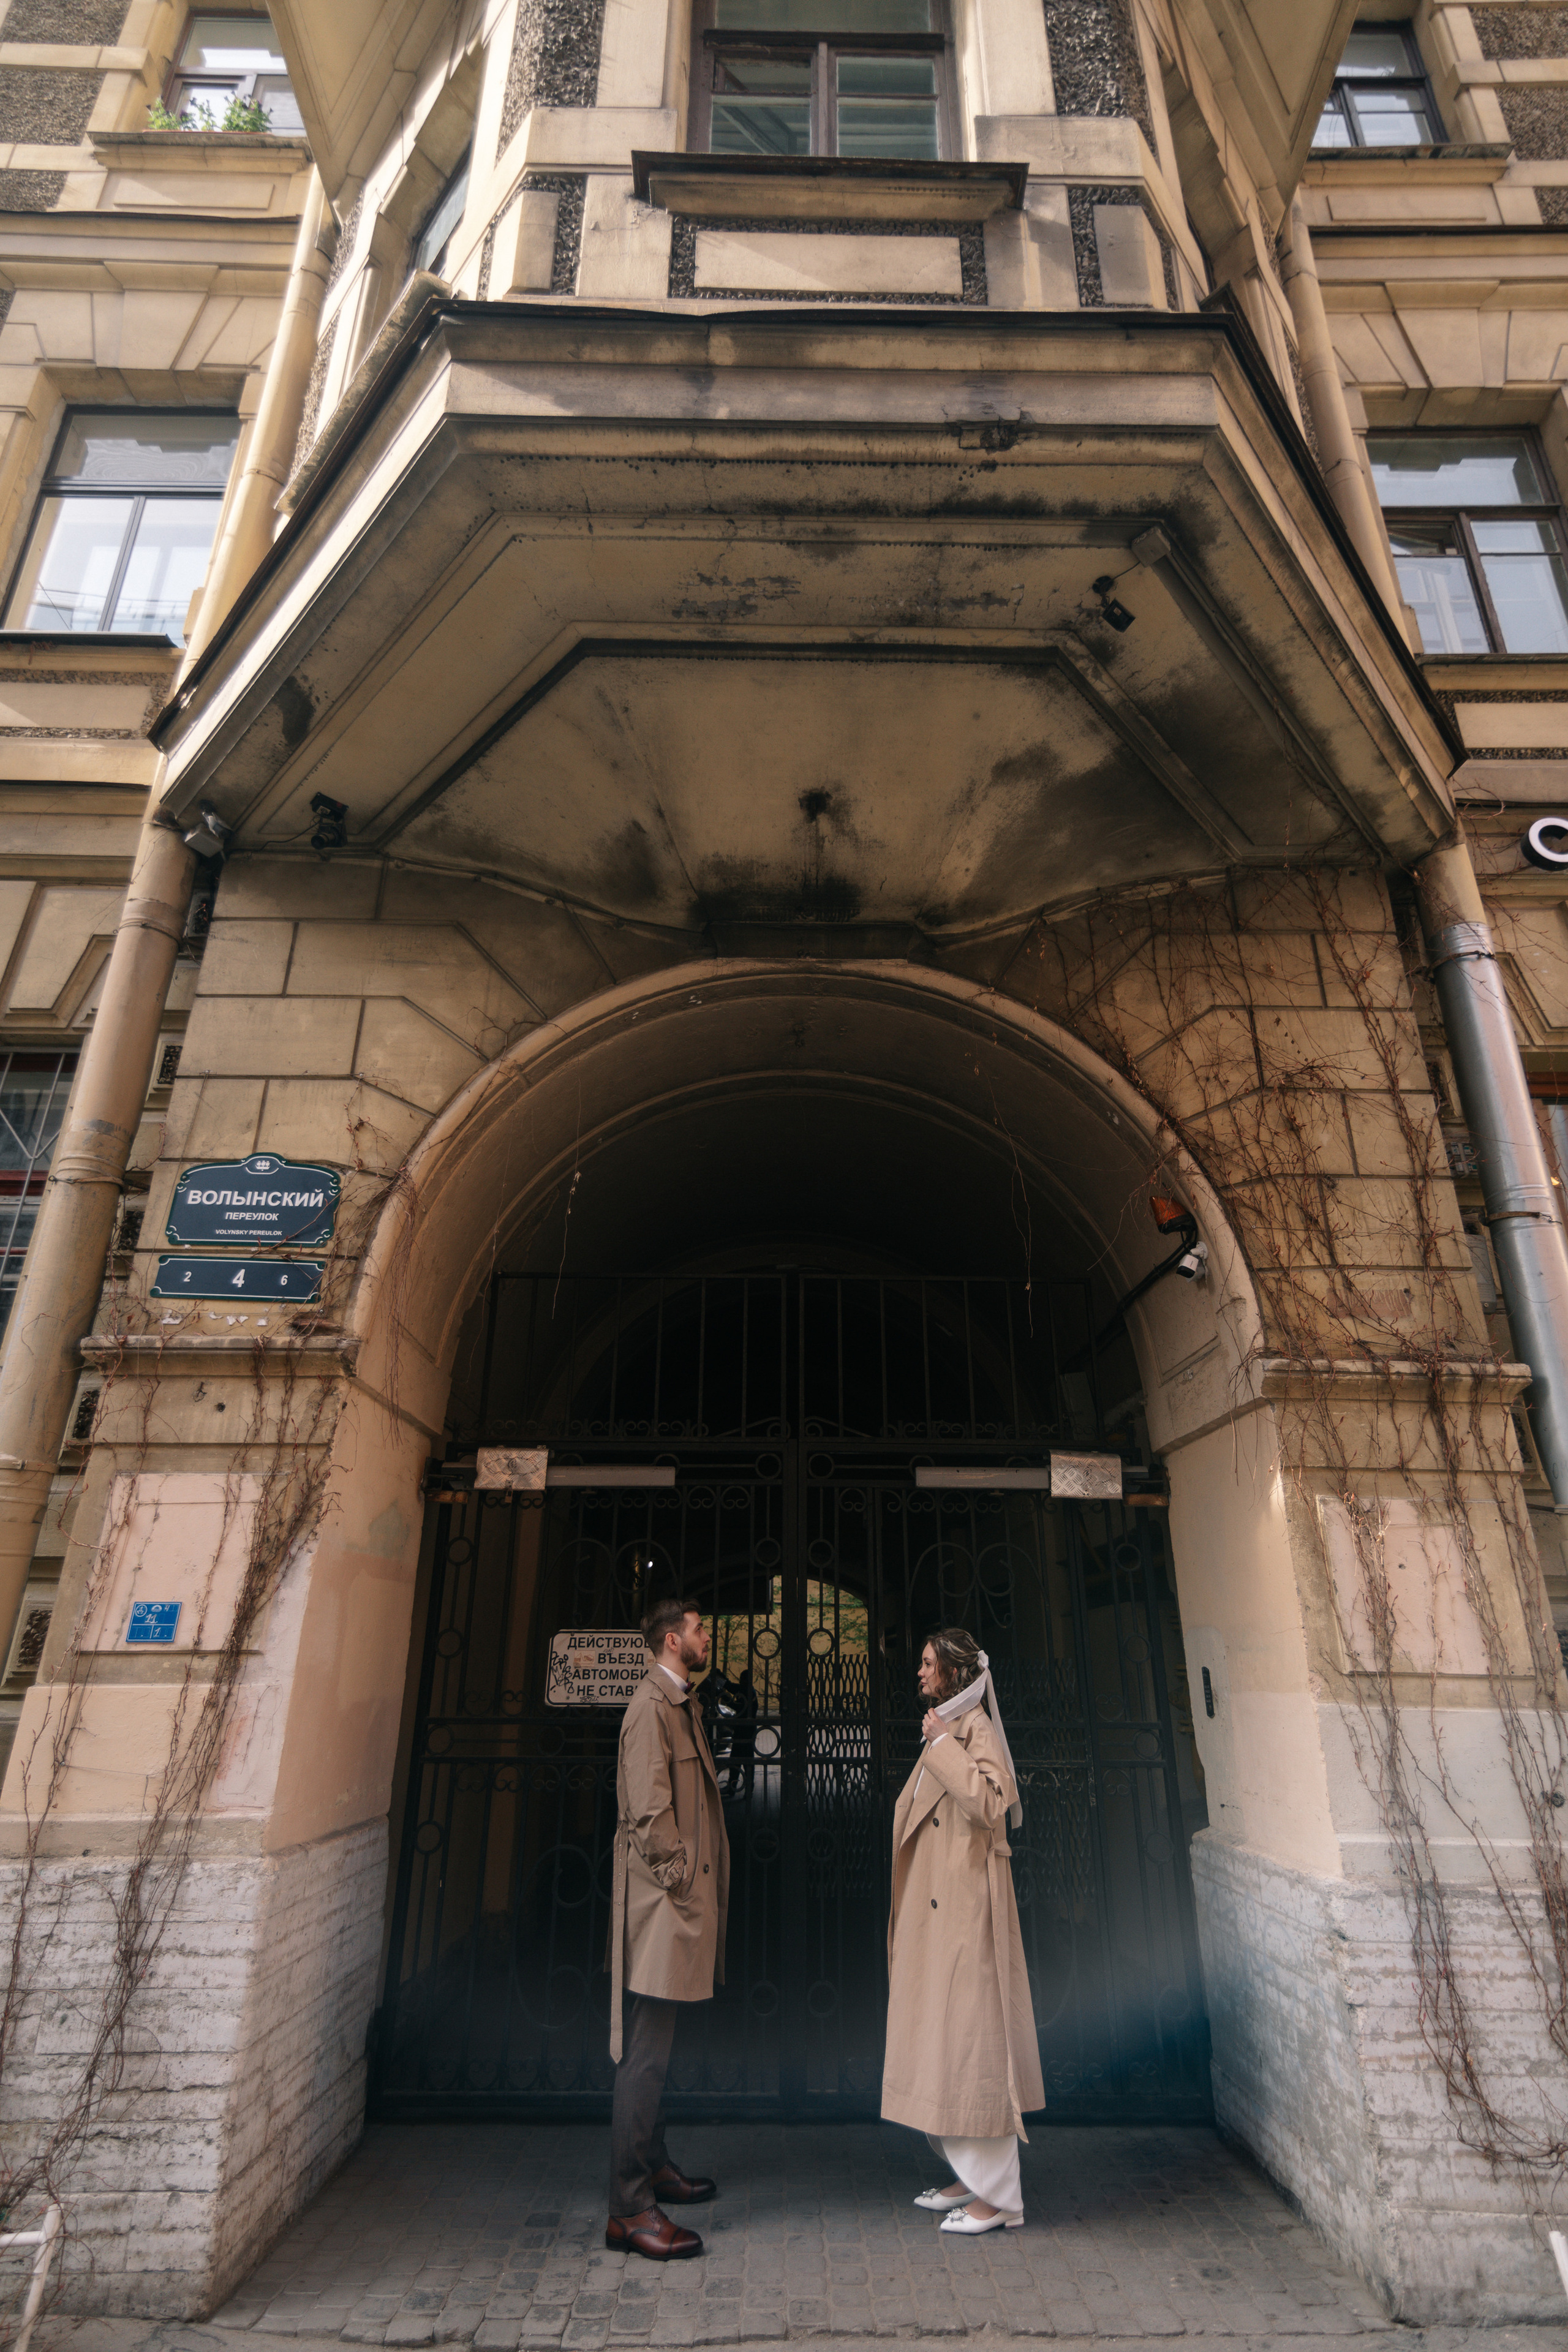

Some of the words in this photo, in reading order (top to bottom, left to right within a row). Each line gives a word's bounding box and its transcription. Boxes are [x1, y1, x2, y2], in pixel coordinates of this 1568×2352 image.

[187, 1188, 325, 1207] ВОЛЫНСКИЙ
[225, 1212, 279, 1221] ПЕРЕУЛОК
[183, 1272, 192, 1282] 2
[232, 1269, 246, 1287] 4
[281, 1275, 288, 1286] 6
[598, 1653, 644, 1666] ВЪЕЗД
[577, 1685, 594, 1696] НЕ
[599, 1685, 638, 1696] СТАВ
